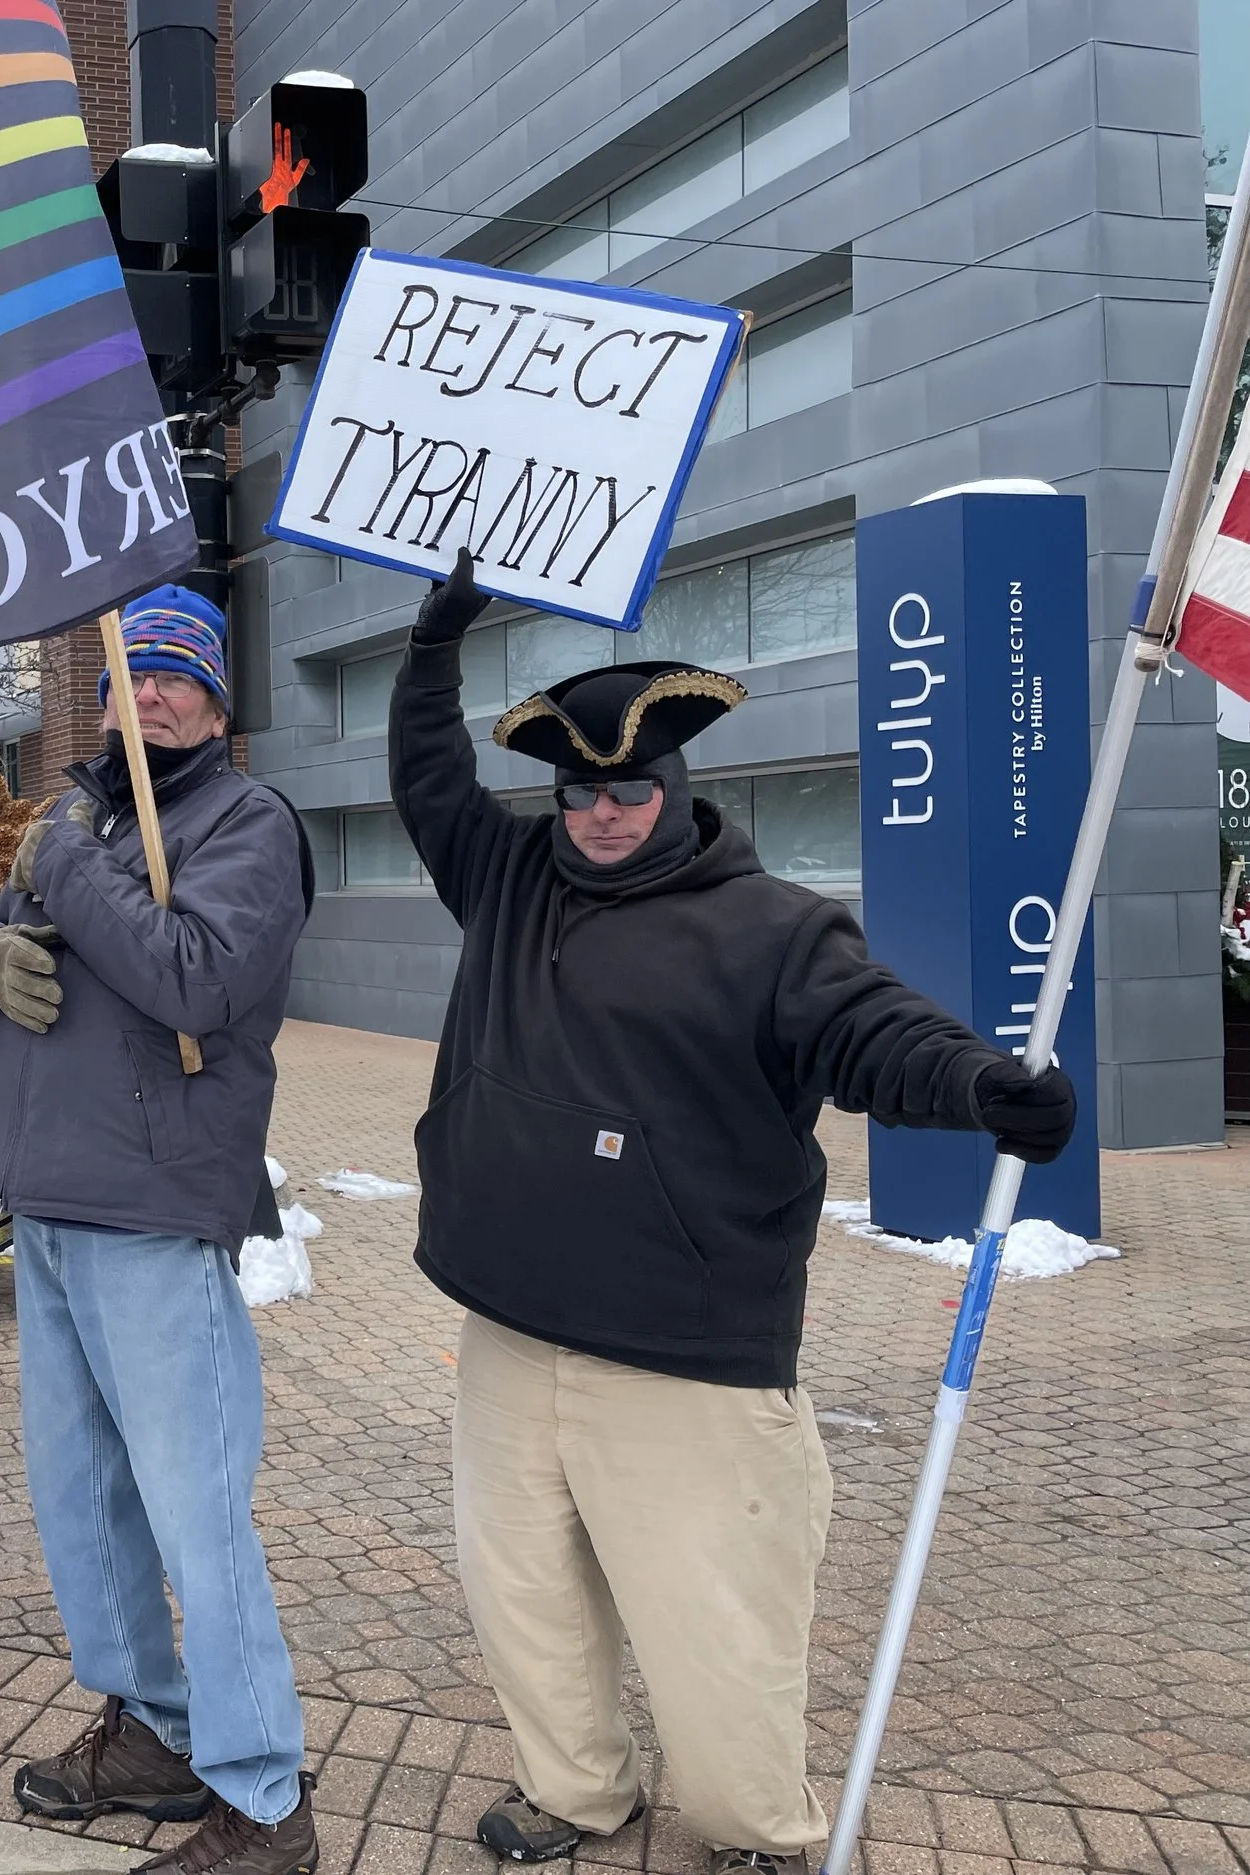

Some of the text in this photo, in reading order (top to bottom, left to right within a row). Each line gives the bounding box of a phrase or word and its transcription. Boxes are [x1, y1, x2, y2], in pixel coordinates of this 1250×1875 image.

[373, 283, 708, 418] REJECT
[310, 416, 657, 588] TYRANNY
[877, 592, 946, 825] tulyp
[1009, 581, 1027, 838] TAPESTRY COLLECTION
[1030, 676, 1046, 751] by Hilton
[1219, 816, 1250, 828] LOU
